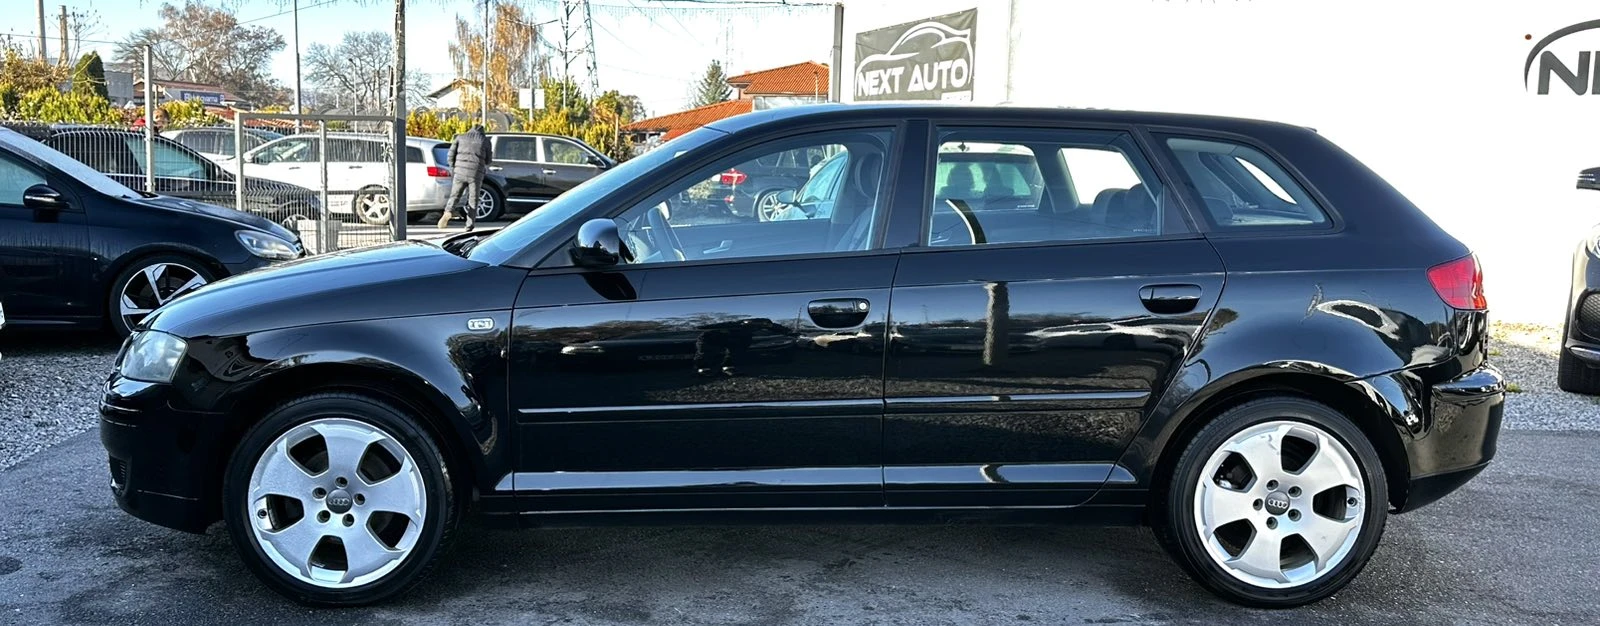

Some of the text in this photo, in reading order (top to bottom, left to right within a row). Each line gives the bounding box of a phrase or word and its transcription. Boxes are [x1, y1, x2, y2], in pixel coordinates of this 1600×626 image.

[857, 58, 969, 97] NEXT AUTO
[1537, 50, 1600, 96] N
